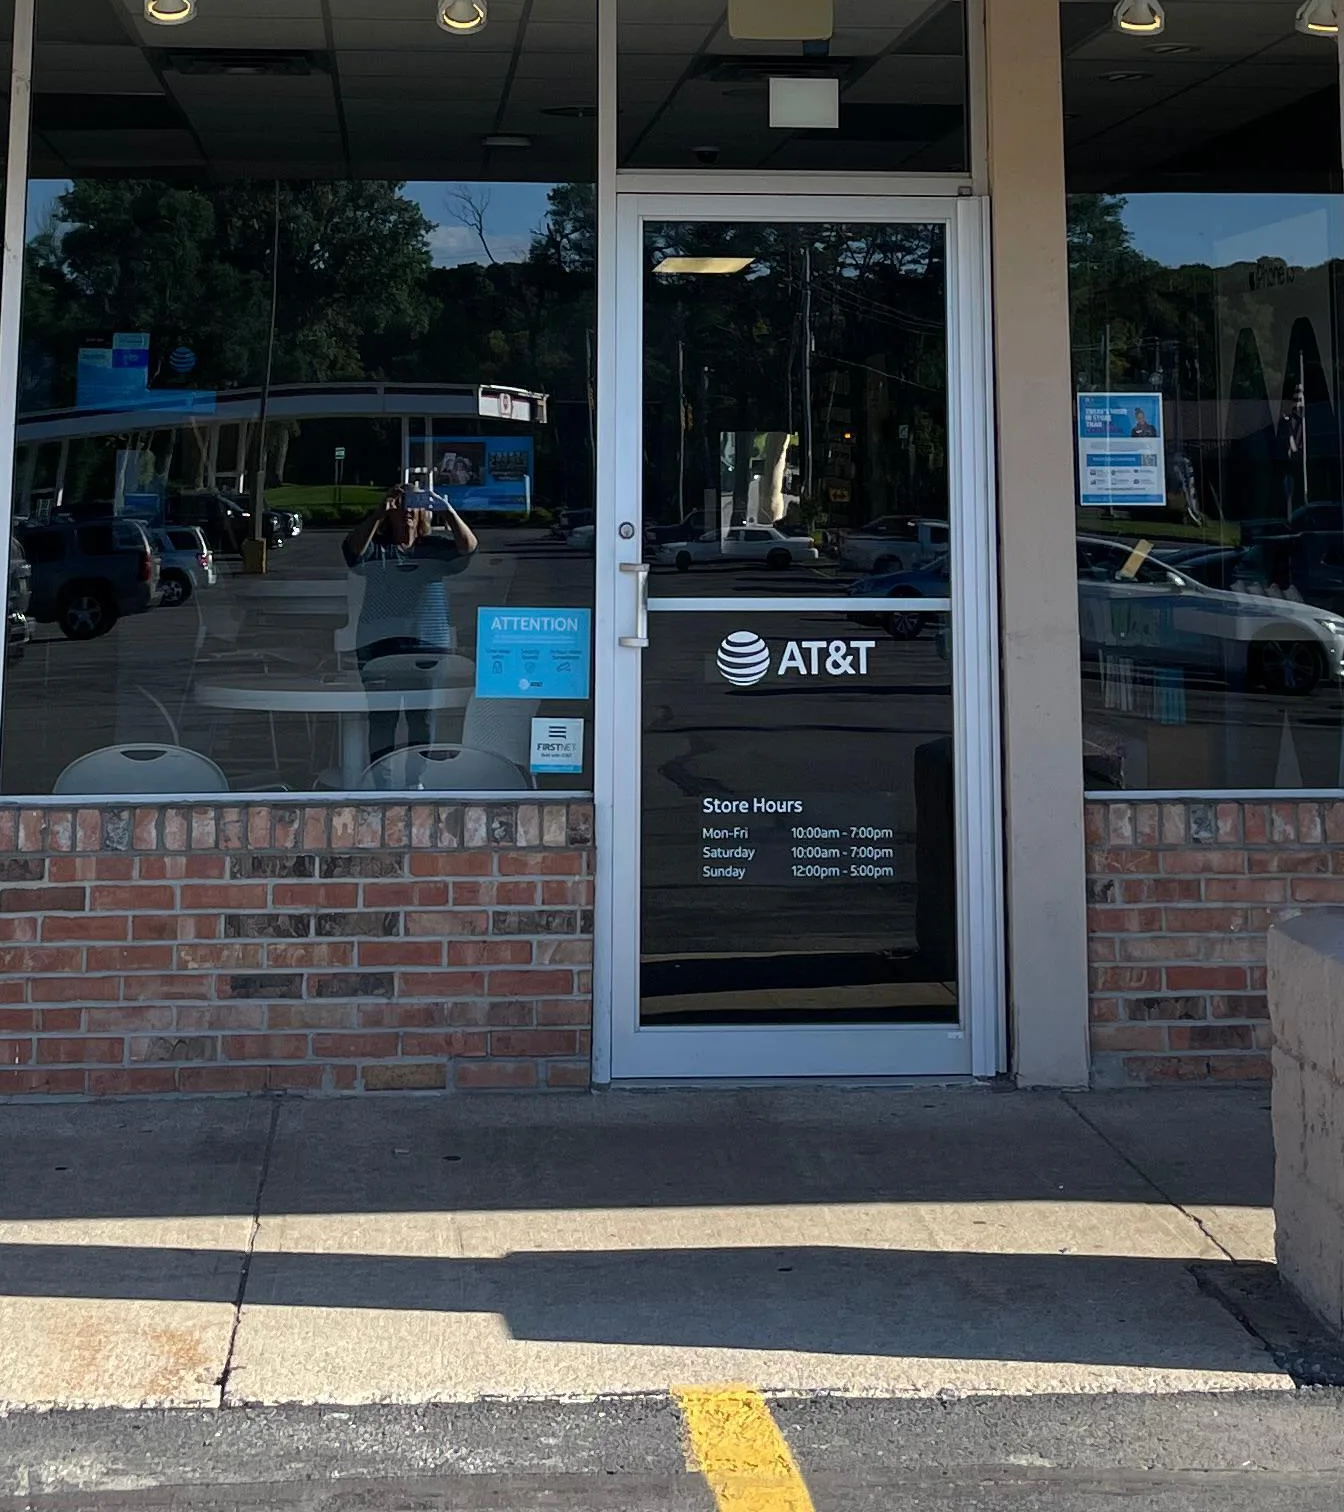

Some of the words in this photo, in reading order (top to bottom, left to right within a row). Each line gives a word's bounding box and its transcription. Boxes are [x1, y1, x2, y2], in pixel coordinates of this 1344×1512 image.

[490, 616, 578, 632] ATTENTION
[777, 640, 876, 676] AT&T
[702, 798, 749, 813] Store
[753, 798, 803, 813] Hours
[702, 827, 749, 839] Mon-Fri
[791, 827, 840, 840] 10:00am
[850, 827, 894, 841] 7:00pm
[702, 846, 756, 861] Saturday
[791, 846, 840, 859] 10:00am
[850, 846, 894, 861] 7:00pm
[702, 866, 746, 880] Sunday
[791, 866, 840, 880] 12:00pm
[850, 865, 894, 880] 5:00pm
